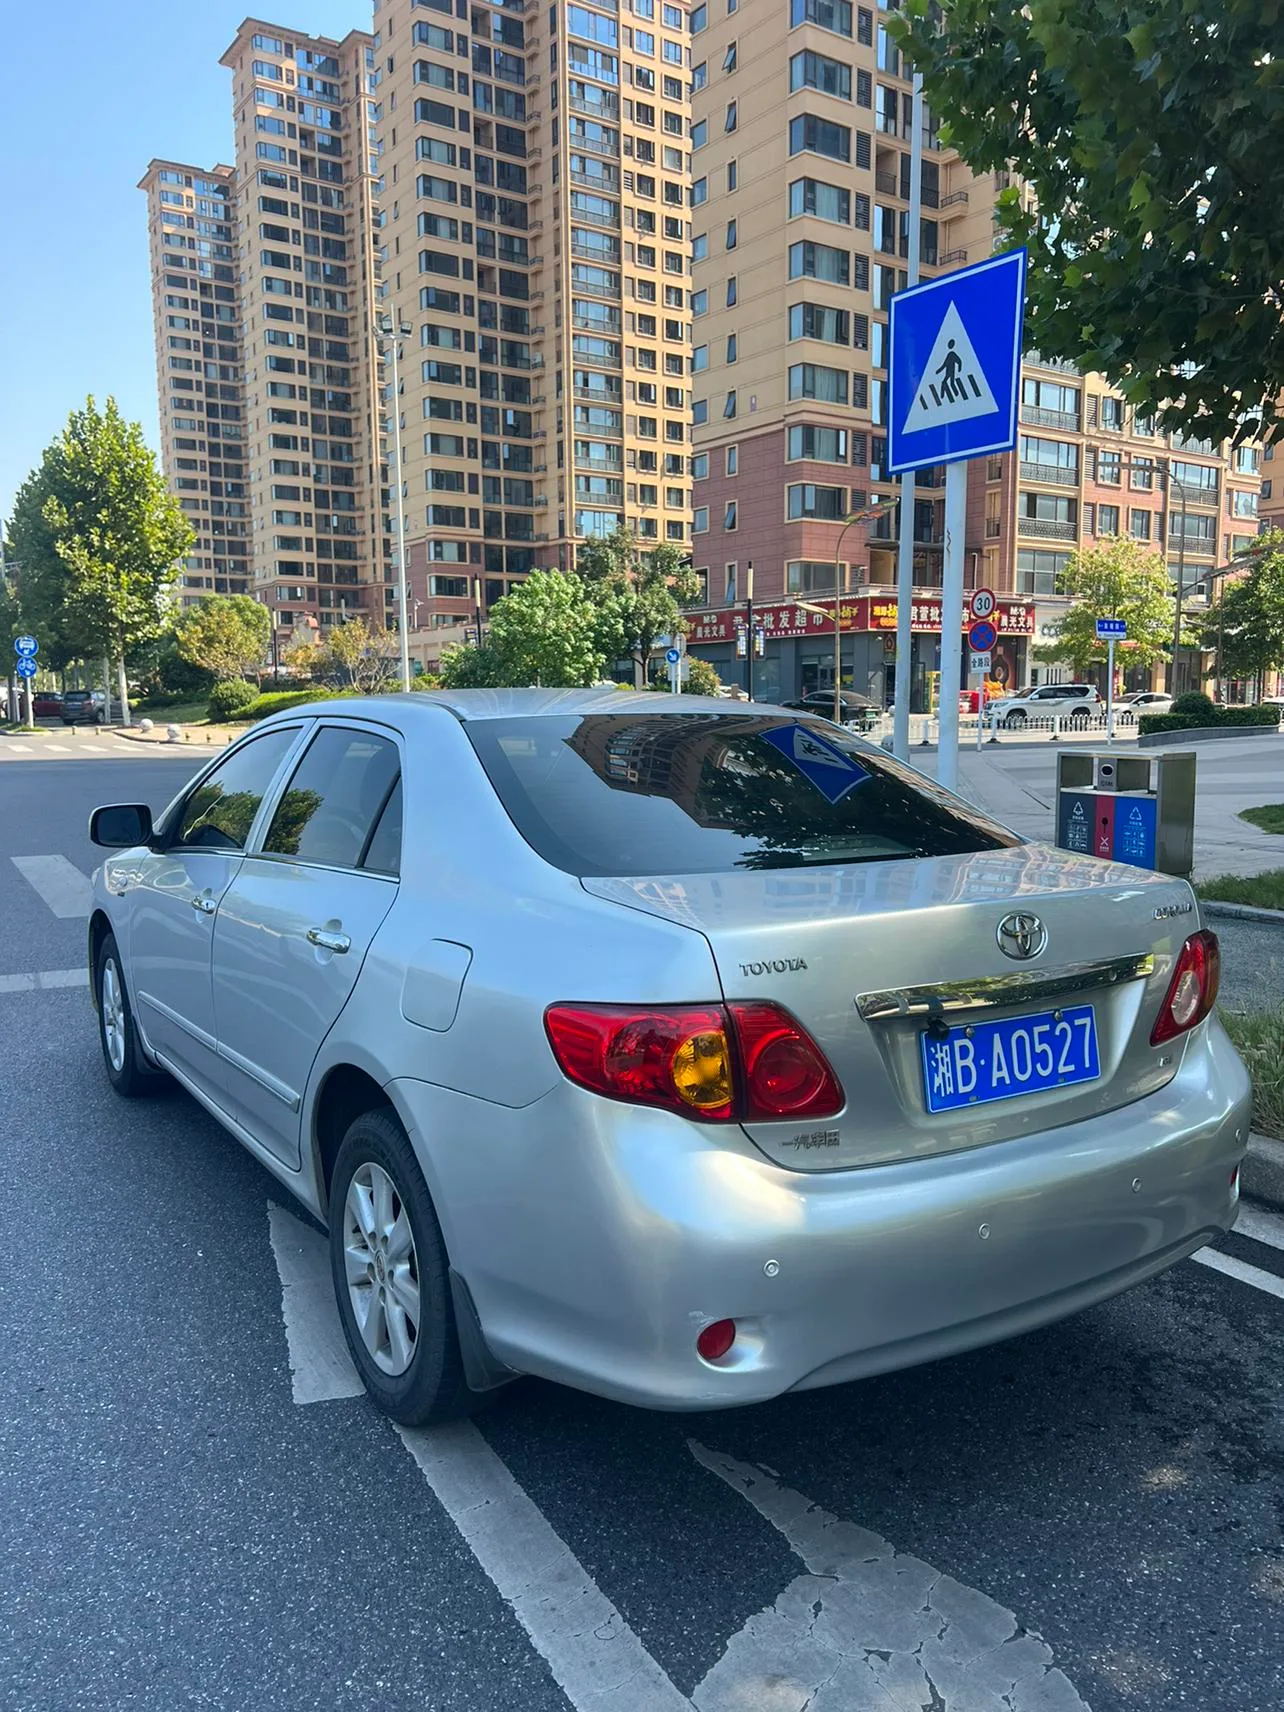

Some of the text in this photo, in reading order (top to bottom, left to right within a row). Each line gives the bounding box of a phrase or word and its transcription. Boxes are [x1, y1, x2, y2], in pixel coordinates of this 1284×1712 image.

[976, 597, 991, 611] 30
[971, 656, 990, 669] 全路段
[739, 957, 808, 977] TOYOTA
